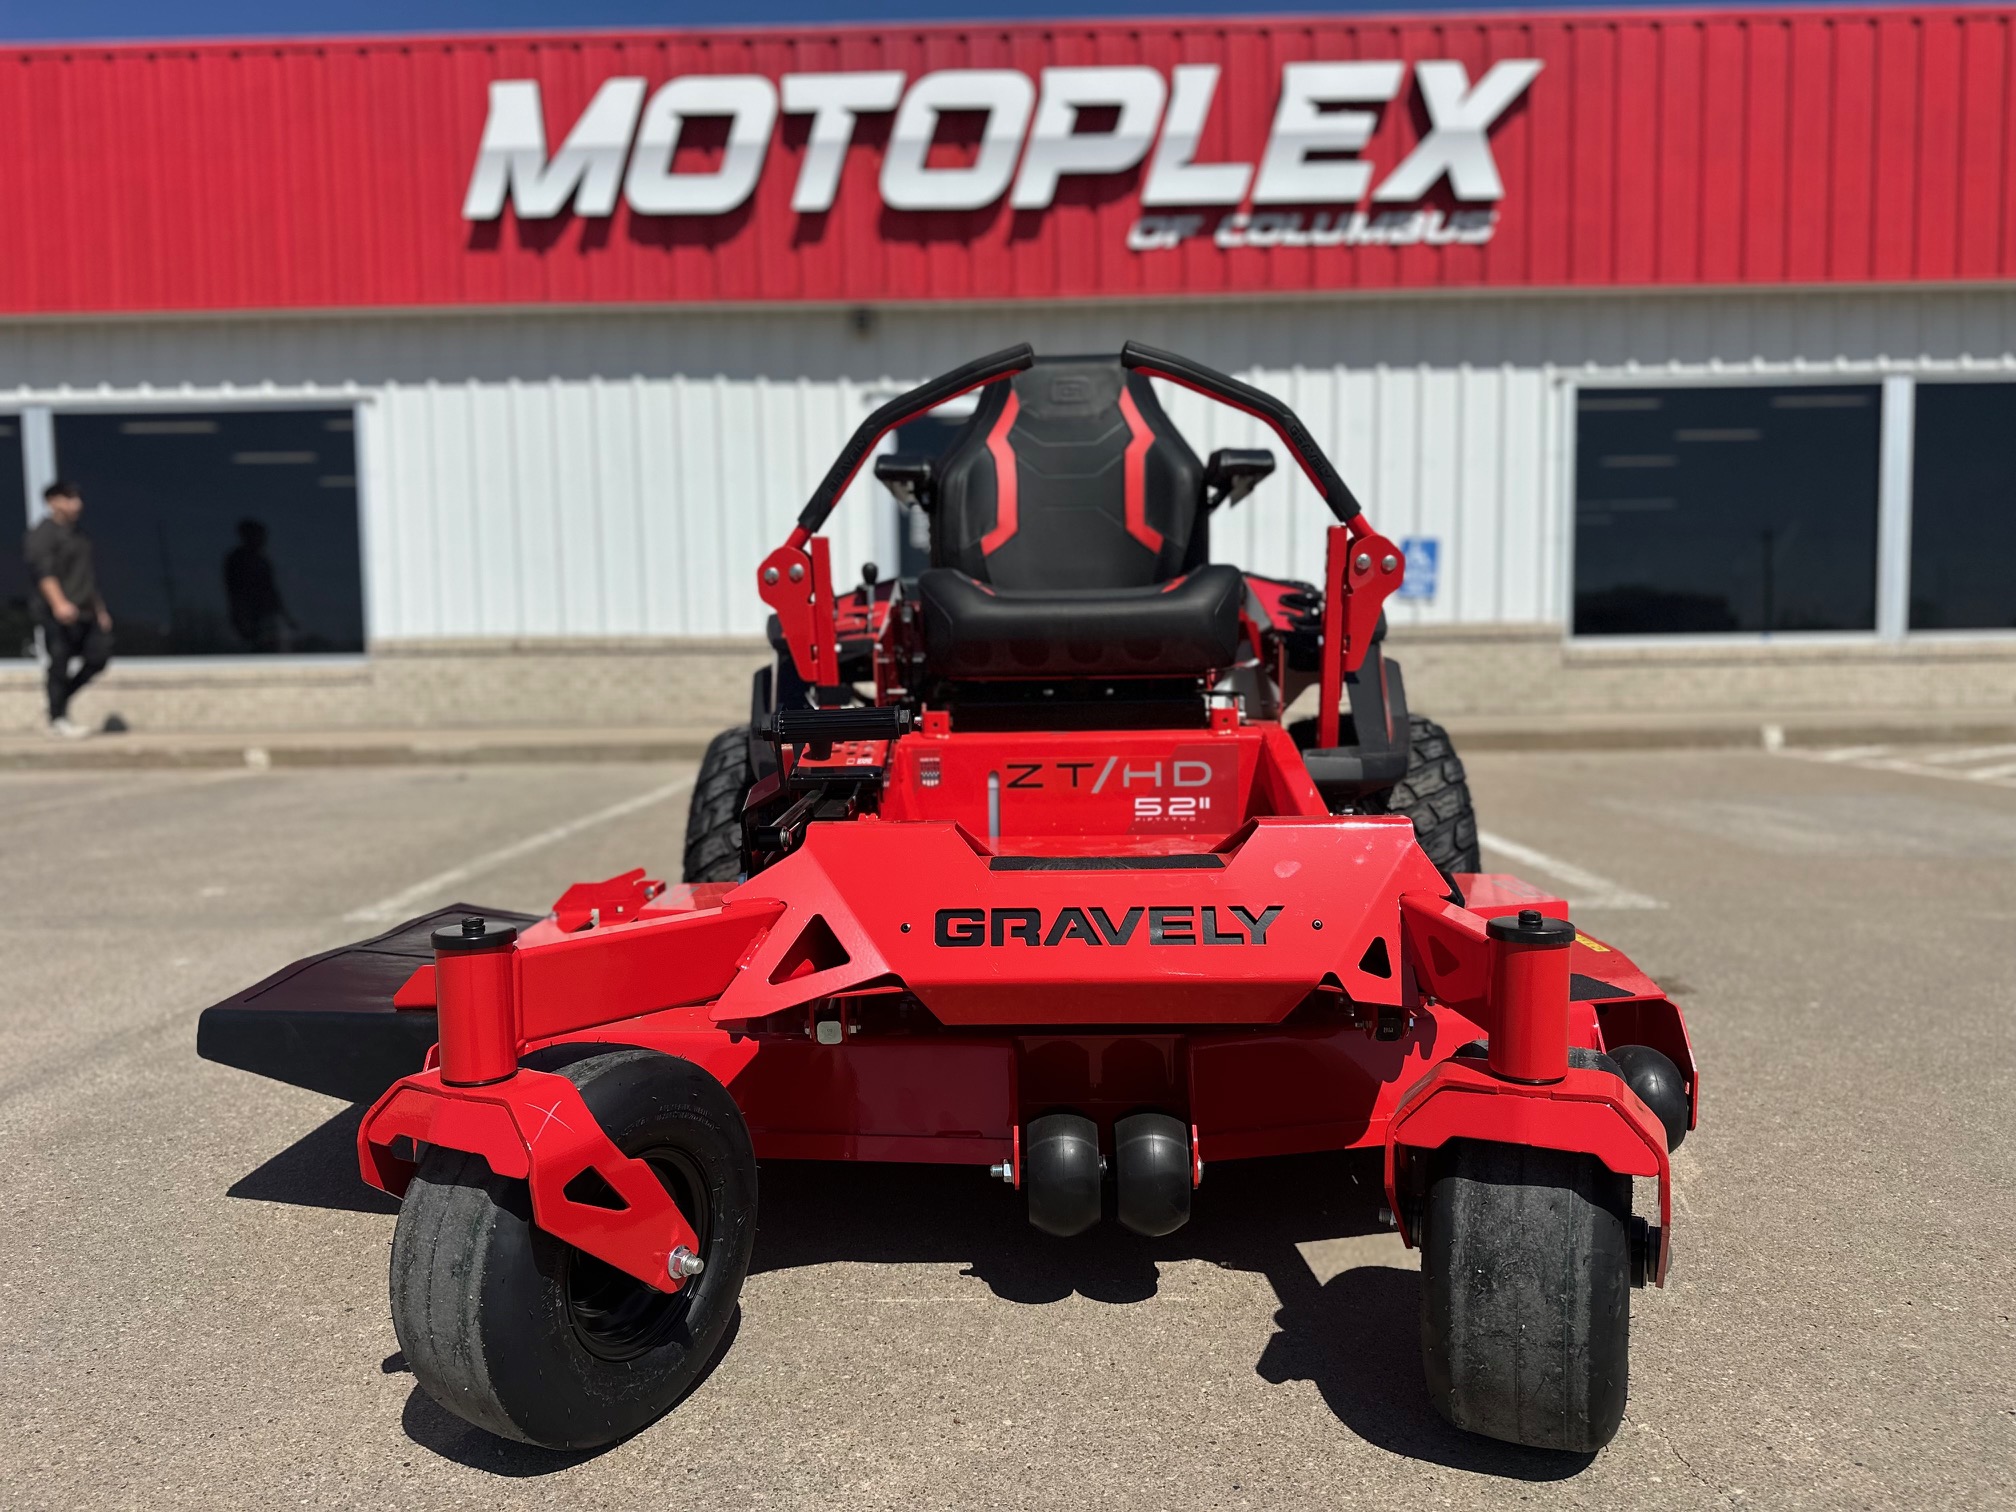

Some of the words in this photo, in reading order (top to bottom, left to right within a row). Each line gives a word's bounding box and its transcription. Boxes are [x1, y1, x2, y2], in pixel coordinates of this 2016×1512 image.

[463, 58, 1545, 221] MOTOPLEX
[1126, 214, 1205, 250] OF
[1214, 209, 1501, 249] COLUMBUS
[1134, 797, 1211, 816] 52"
[934, 905, 1287, 948] GRAVELY
